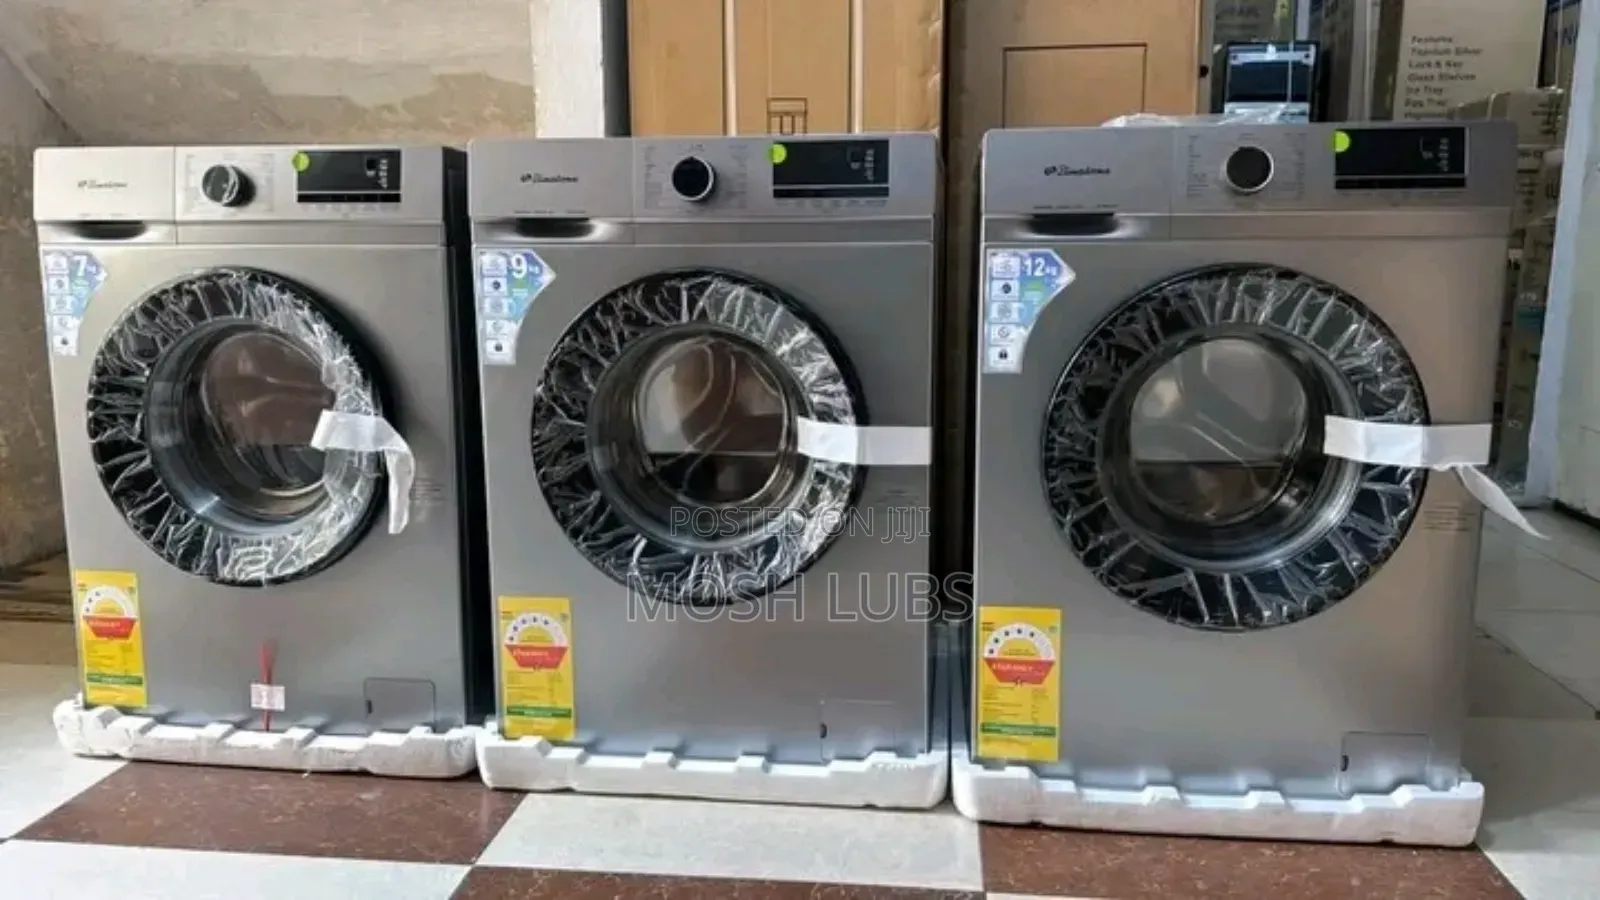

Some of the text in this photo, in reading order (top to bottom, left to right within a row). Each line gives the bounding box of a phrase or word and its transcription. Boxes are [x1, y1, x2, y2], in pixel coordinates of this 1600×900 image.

[73, 254, 88, 276] 7
[511, 253, 529, 279] 9
[1024, 257, 1045, 276] 12
